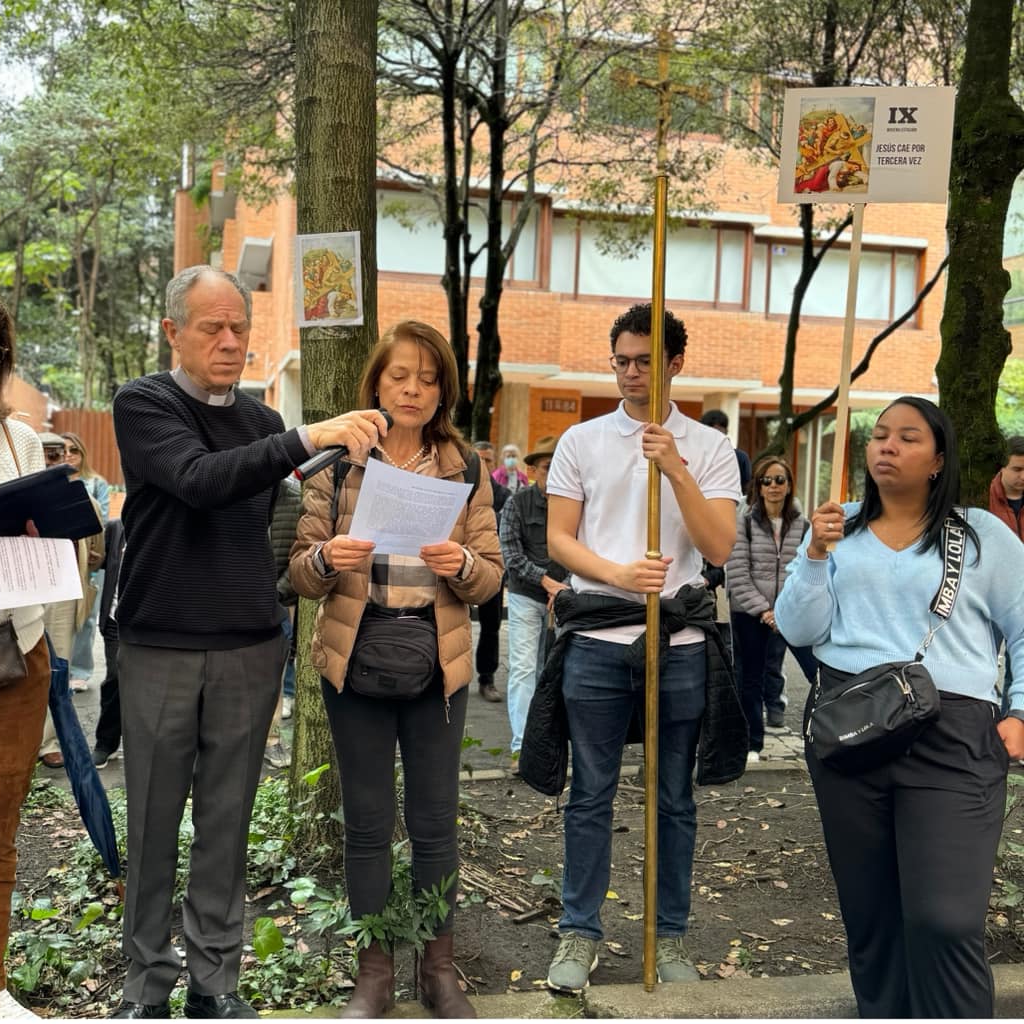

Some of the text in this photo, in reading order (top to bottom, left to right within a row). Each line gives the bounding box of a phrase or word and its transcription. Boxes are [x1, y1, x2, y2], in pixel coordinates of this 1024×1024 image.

[887, 106, 919, 124] IX
[896, 143, 910, 153] CAE
[911, 143, 926, 153] POR
[877, 156, 922, 166] TERCERA VEZ
[947, 561, 960, 575] Y
